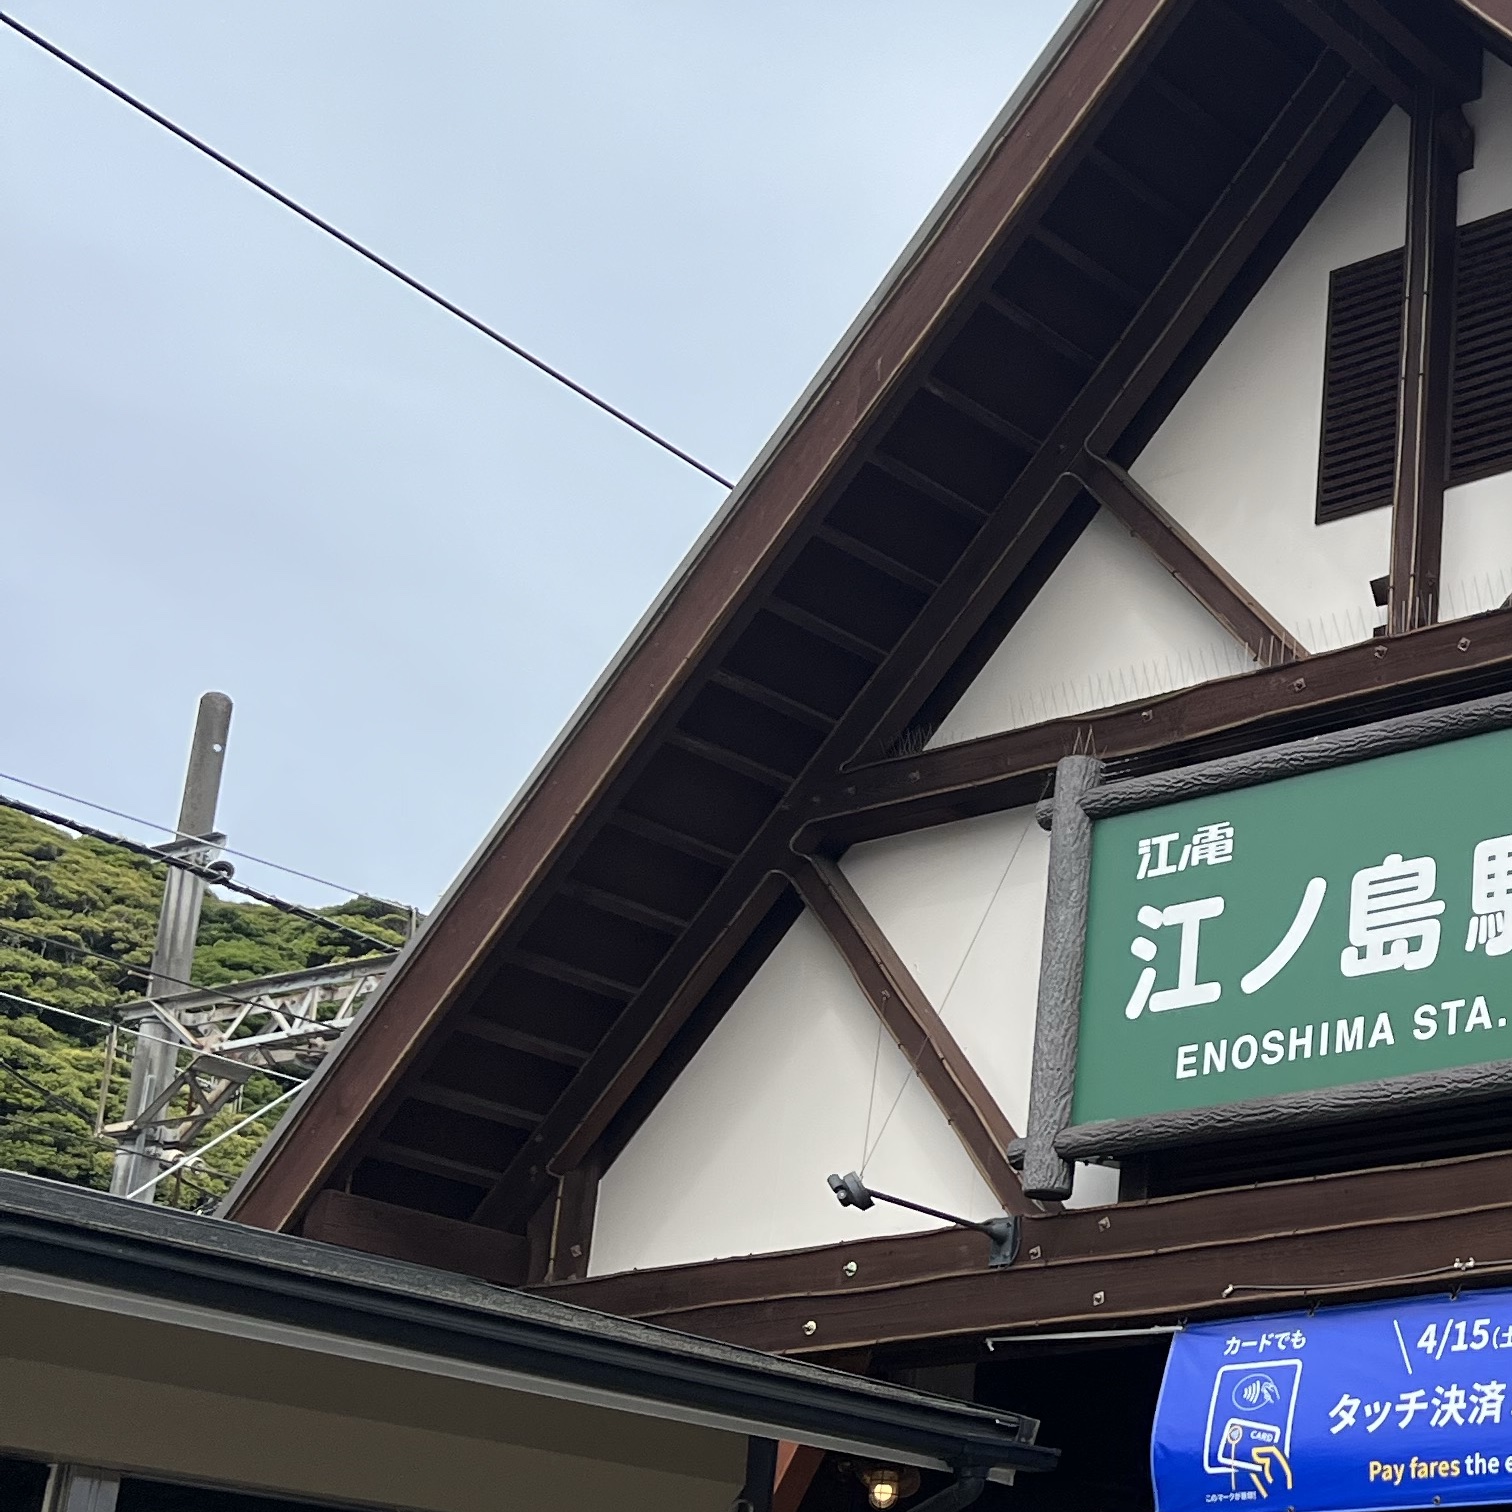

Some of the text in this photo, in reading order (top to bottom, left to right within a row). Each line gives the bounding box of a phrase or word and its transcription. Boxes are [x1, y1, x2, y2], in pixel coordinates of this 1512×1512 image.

[1176, 996, 1507, 1080] ENOSHIMA STA.
[1223, 1330, 1306, 1356] カードでも
[1328, 1381, 1507, 1437] タッチ決済
[1250, 1430, 1273, 1443] CARD
[1369, 1460, 1403, 1486] Pay
[1410, 1457, 1460, 1480] fares
[1465, 1453, 1499, 1475] the
